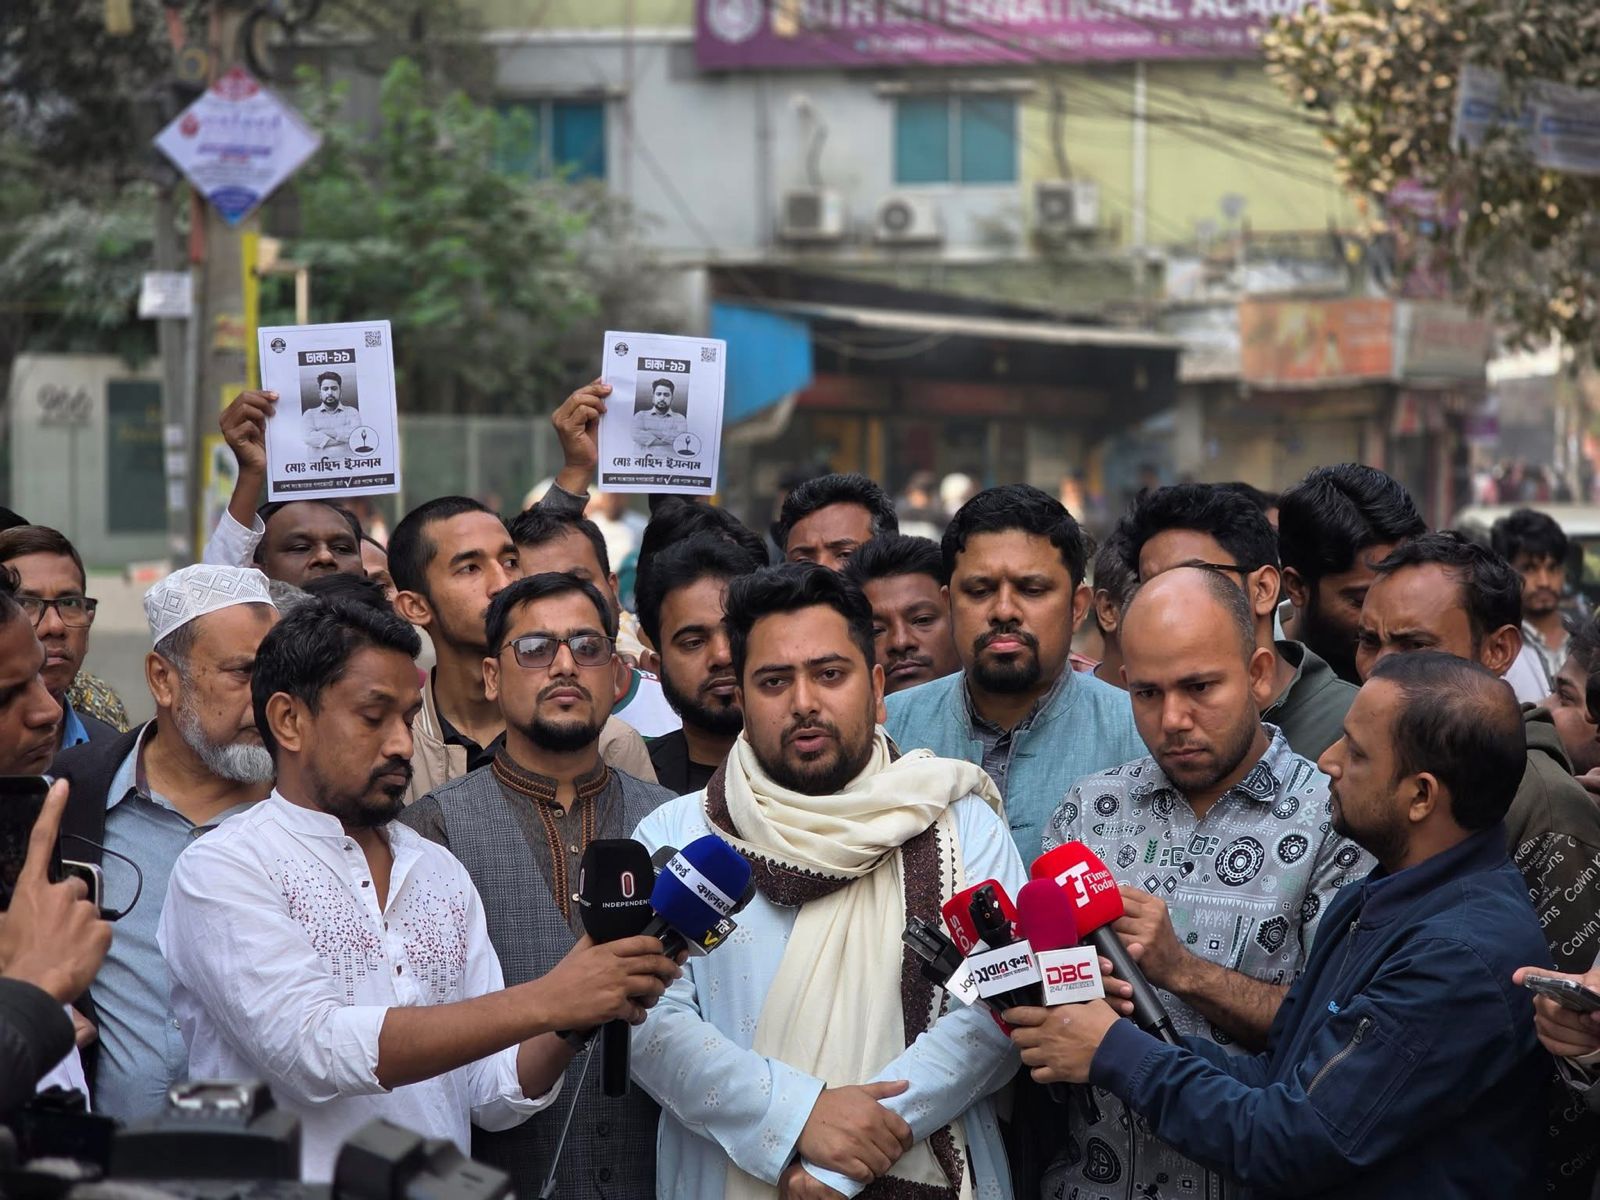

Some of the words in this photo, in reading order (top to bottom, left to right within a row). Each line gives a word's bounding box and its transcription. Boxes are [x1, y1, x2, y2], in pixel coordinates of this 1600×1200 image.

[305, 352, 350, 364] ঢাকা-১১
[644, 359, 686, 372] ঢাকা-১১
[285, 462, 306, 474] মোঃ
[309, 456, 341, 473] নাহিদ
[344, 457, 382, 471] ইসলাম
[613, 456, 631, 467] মোঃ
[634, 454, 663, 468] নাহিদ
[666, 457, 701, 470] ইসলাম
[1089, 879, 1115, 894] Today
[1564, 866, 1597, 902] Calvin
[1561, 920, 1600, 956] Calvin
[1045, 962, 1093, 985] DBC
